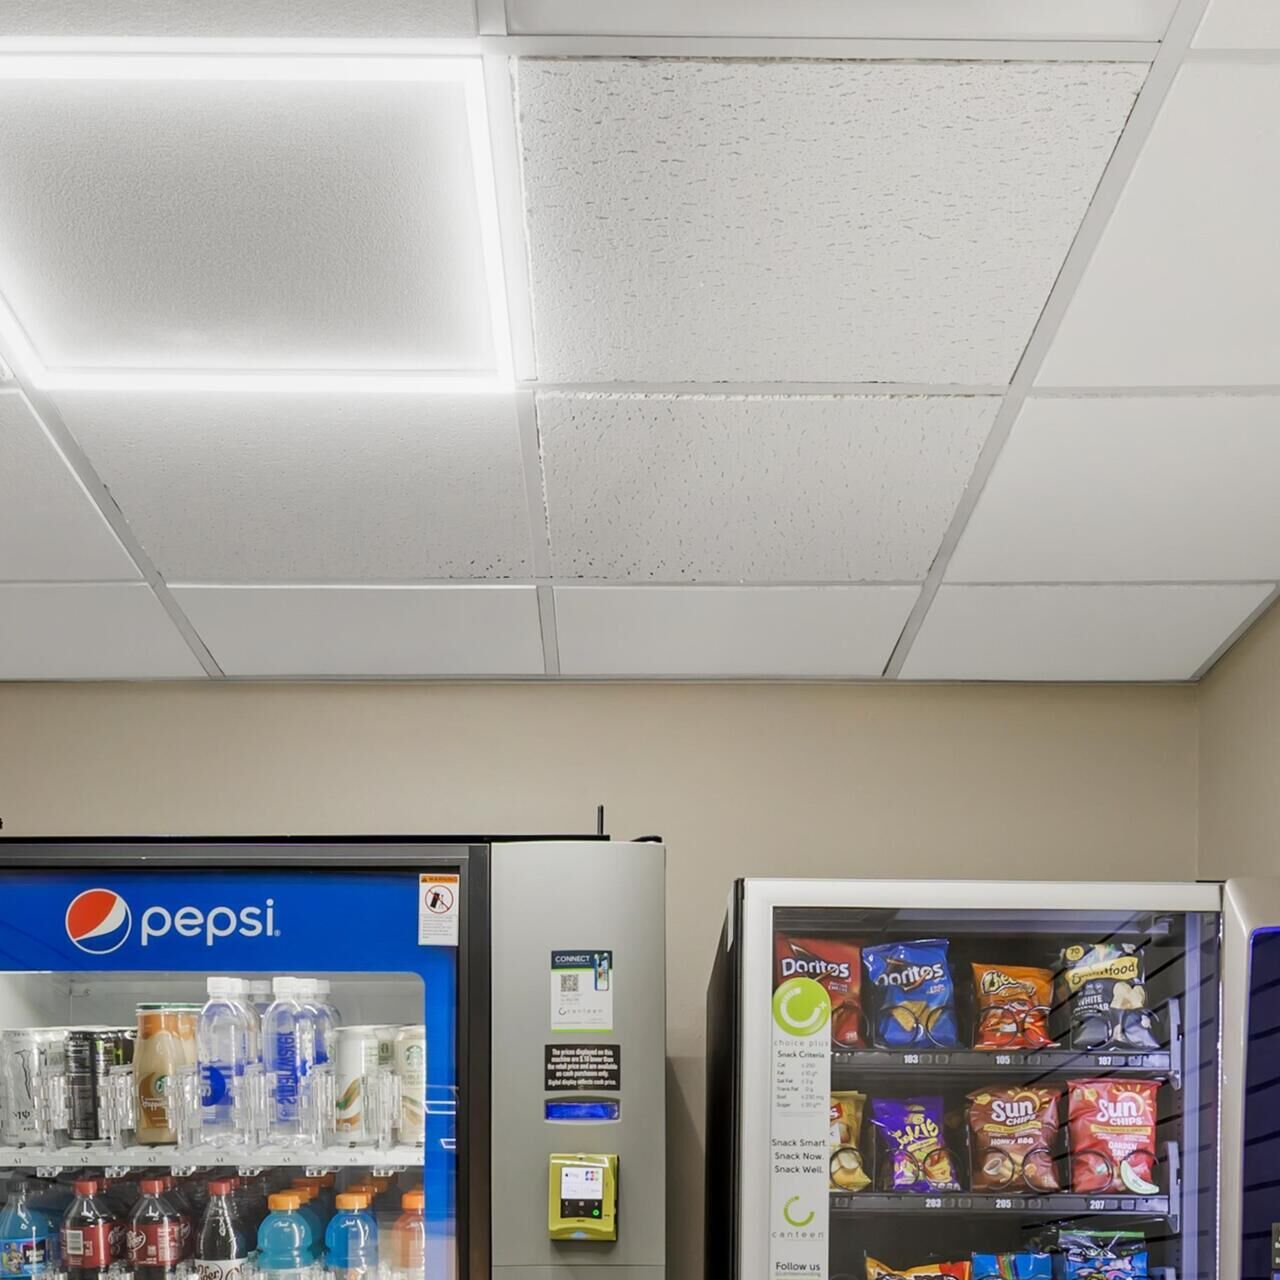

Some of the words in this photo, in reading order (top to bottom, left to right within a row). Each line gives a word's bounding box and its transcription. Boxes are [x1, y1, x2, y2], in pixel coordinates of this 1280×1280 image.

[141, 898, 274, 946] pepsi
[554, 955, 591, 963] CONNECT
[782, 957, 850, 977] Doritos
[809, 1040, 829, 1048] plus
[777, 1051, 797, 1059] Snack
[799, 1051, 825, 1059] Criteria
[996, 1056, 1010, 1065] 105
[1098, 1056, 1112, 1065] 107
[991, 1100, 1034, 1122] Sun
[1096, 1100, 1137, 1122] Sun
[1006, 1114, 1036, 1126] CHIPS
[1109, 1116, 1143, 1126] CHIPS
[772, 1139, 797, 1147] Snack
[775, 1152, 800, 1160] Snack
[803, 1152, 824, 1160] Now.
[925, 1199, 941, 1208] 203
[995, 1199, 1012, 1209] 205
[1090, 1200, 1105, 1209] 207
[776, 1262, 807, 1271] Follow
